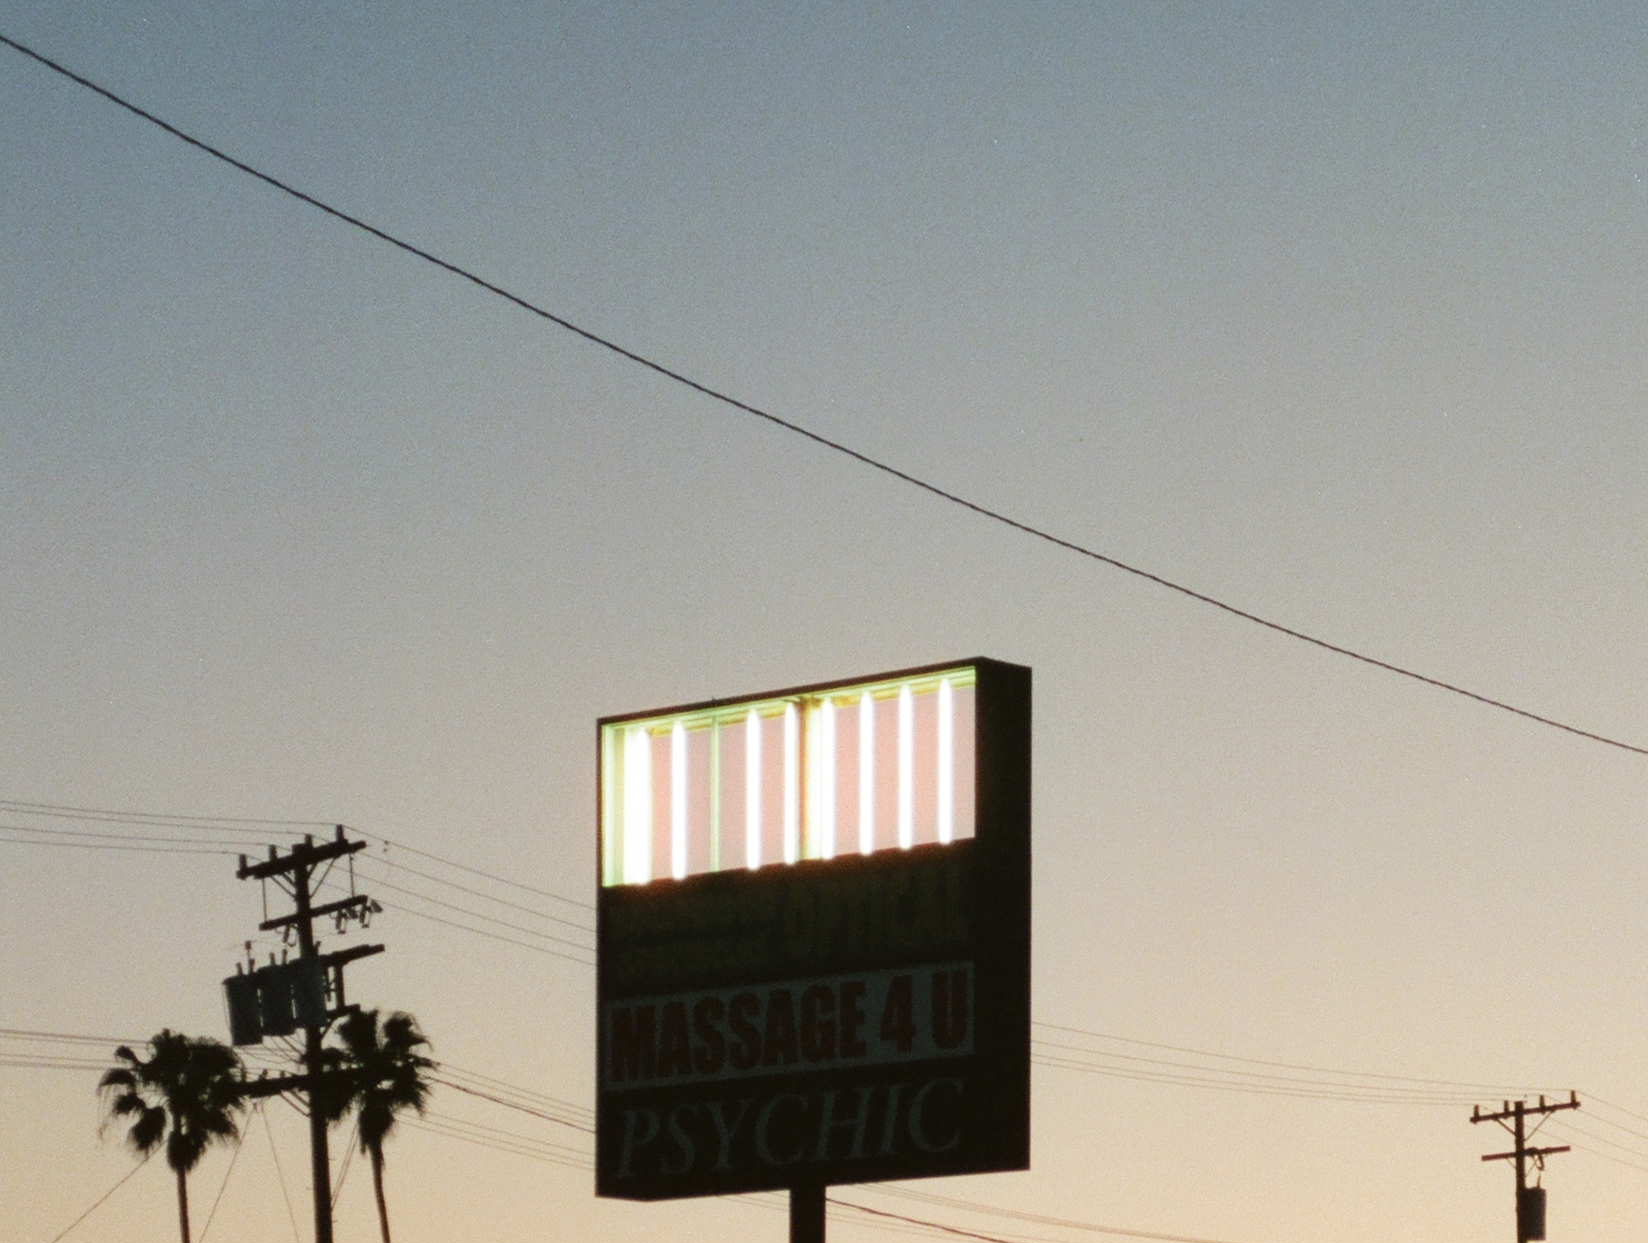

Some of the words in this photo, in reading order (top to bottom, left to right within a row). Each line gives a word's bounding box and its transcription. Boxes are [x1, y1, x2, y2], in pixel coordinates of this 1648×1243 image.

[611, 979, 869, 1083] MASSAGE
[878, 973, 918, 1055] 4
[930, 968, 970, 1051] U
[616, 1077, 966, 1179] PSYCHIC
